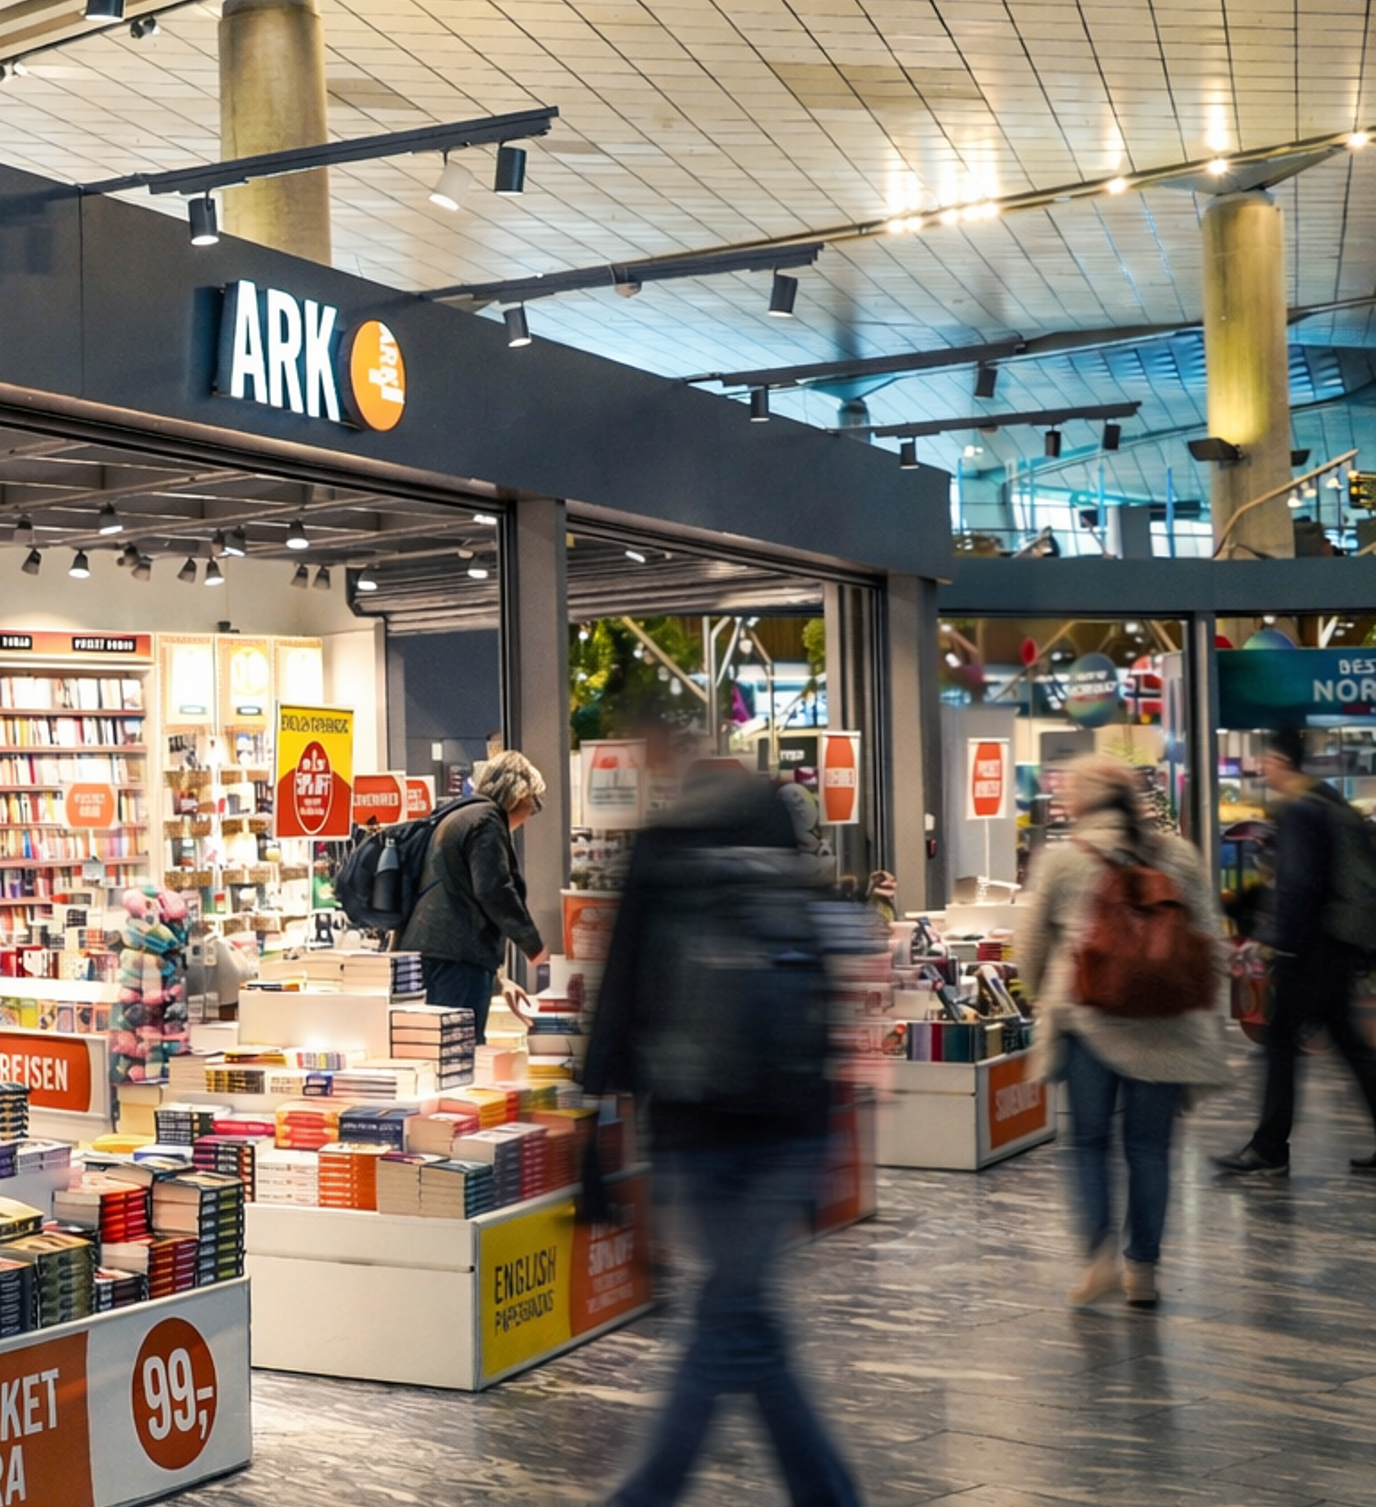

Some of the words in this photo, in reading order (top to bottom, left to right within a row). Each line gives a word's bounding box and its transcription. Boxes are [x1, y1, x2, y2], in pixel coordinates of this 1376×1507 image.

[230, 279, 341, 422] ARK
[494, 1246, 557, 1305] ENGLISH
[142, 1347, 214, 1441] 99,-
